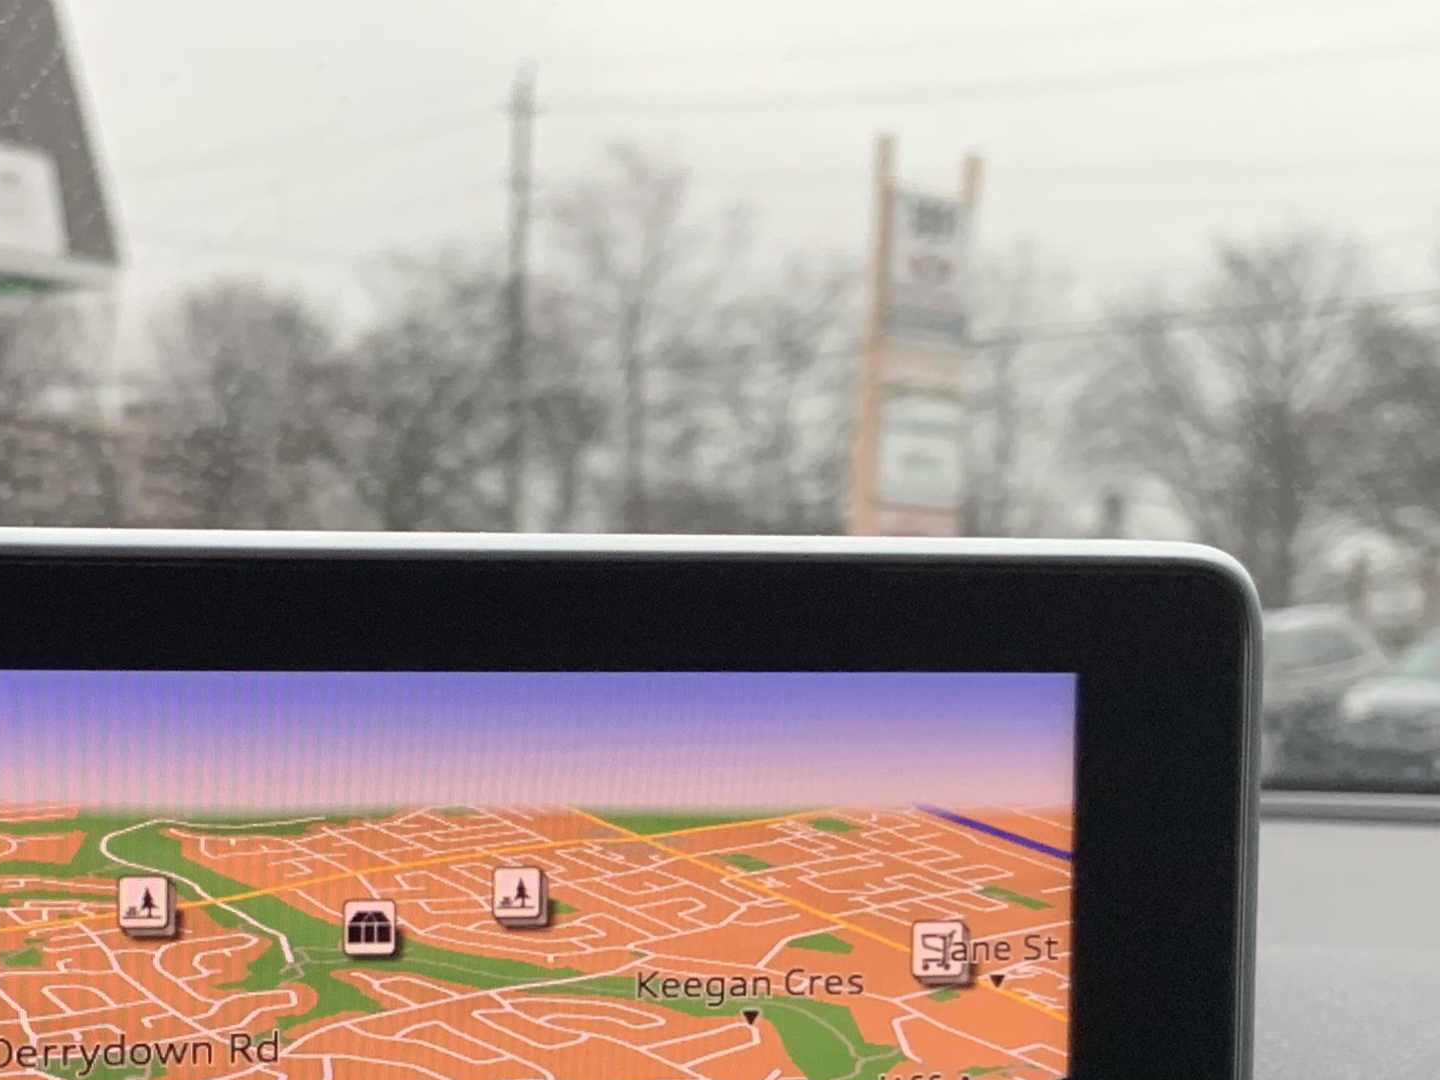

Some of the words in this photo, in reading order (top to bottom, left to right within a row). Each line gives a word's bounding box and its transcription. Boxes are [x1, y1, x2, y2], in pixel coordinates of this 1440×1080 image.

[1024, 934, 1059, 961] St
[636, 970, 772, 1007] Keegan
[784, 967, 864, 997] Cres
[229, 1031, 280, 1064] Rd
